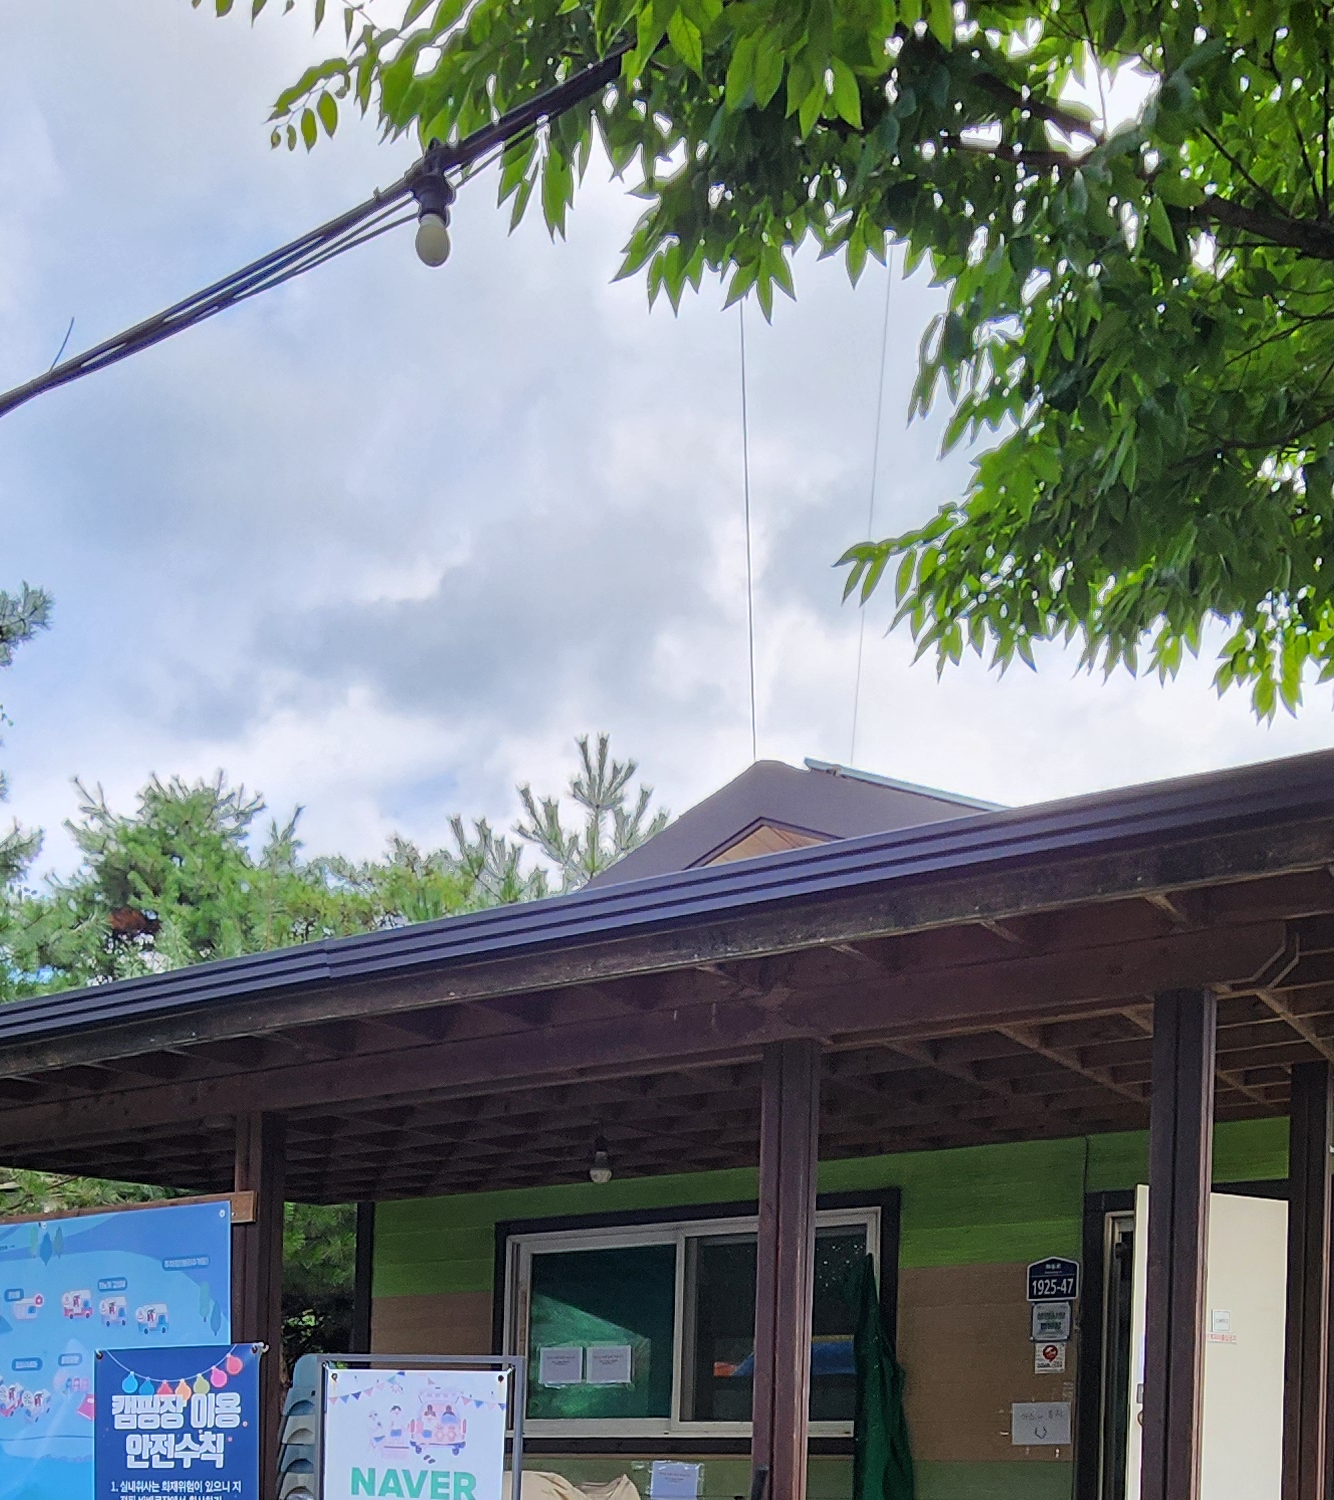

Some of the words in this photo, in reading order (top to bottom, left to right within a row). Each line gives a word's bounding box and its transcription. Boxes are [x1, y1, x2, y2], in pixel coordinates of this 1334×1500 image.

[1033, 1278, 1073, 1295] 1925-47
[112, 1393, 187, 1429] 캠핑장
[190, 1393, 241, 1428] 이용
[126, 1430, 224, 1468] 안전수칙
[111, 1481, 118, 1492] 1.
[120, 1481, 160, 1492] 실내취사는
[162, 1481, 202, 1492] 화재위험이
[205, 1481, 230, 1492] 있으니
[232, 1481, 241, 1492] 지
